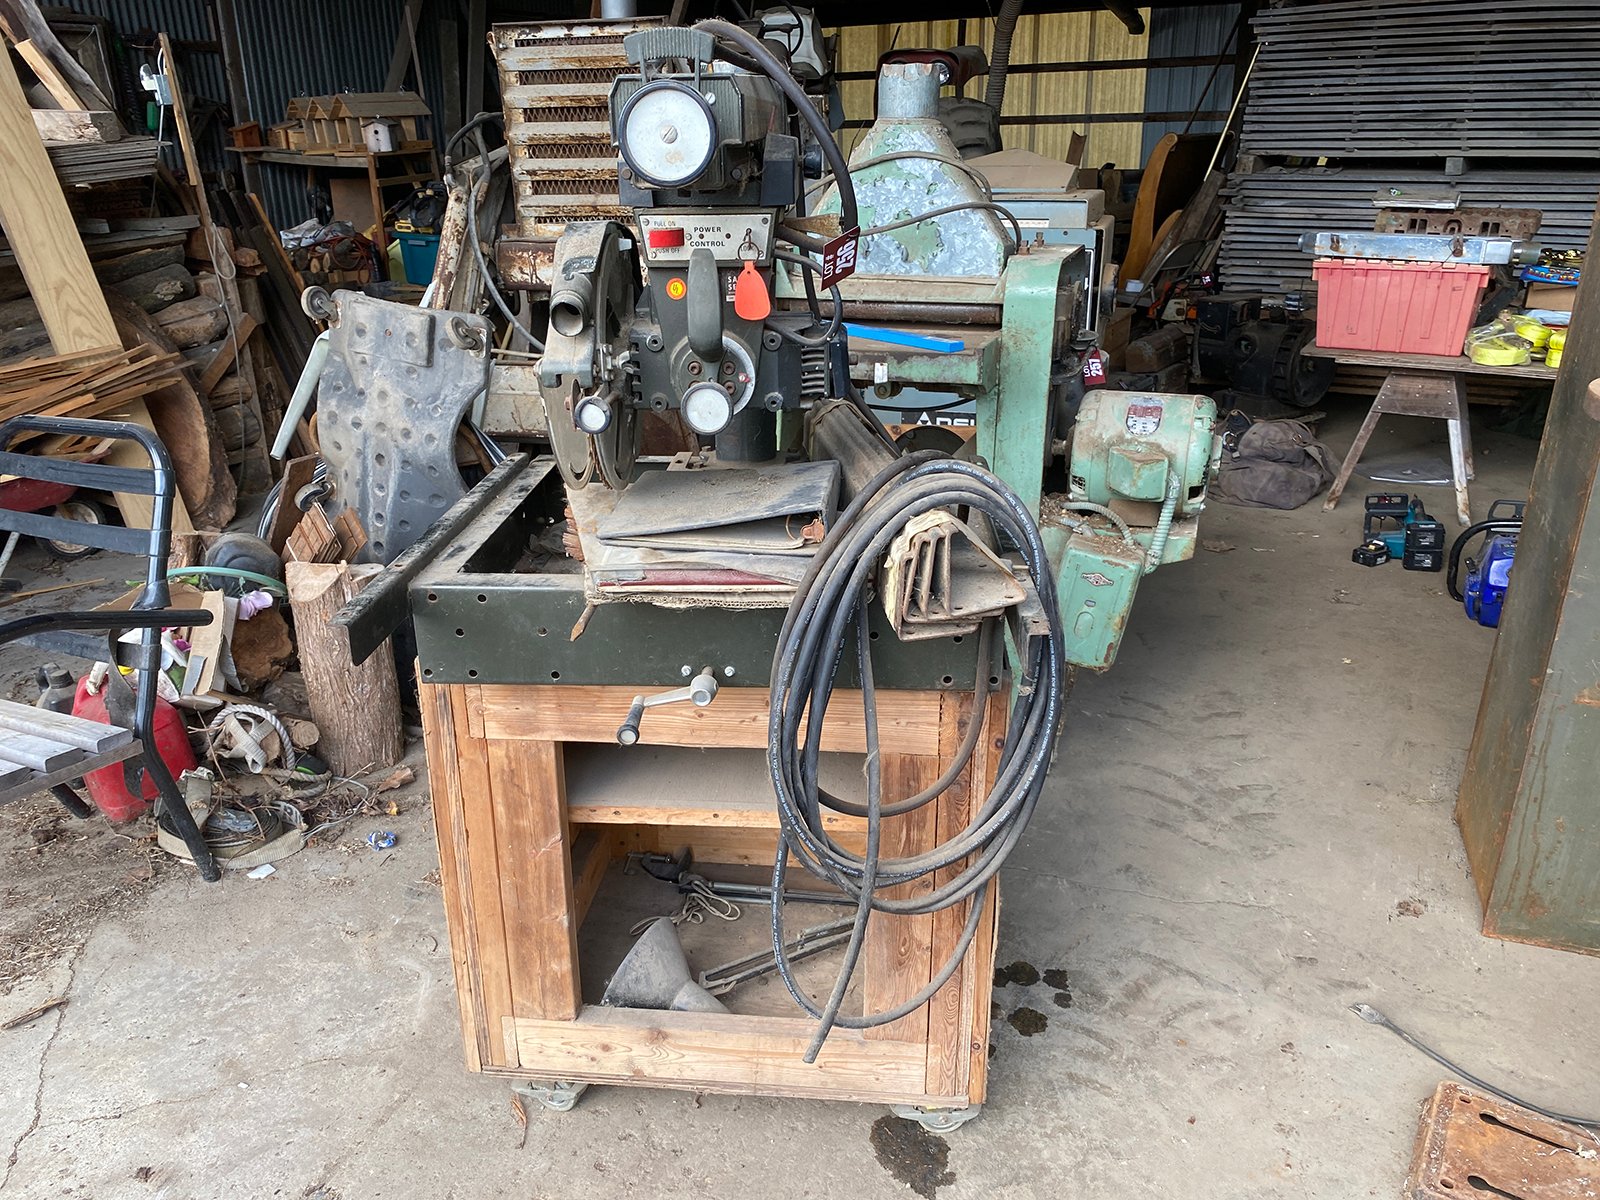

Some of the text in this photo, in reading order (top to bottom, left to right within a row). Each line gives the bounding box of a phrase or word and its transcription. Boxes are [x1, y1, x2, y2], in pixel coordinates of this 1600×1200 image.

[824, 261, 834, 280] LOT
[836, 240, 856, 274] 256
[1088, 358, 1102, 376] 257
